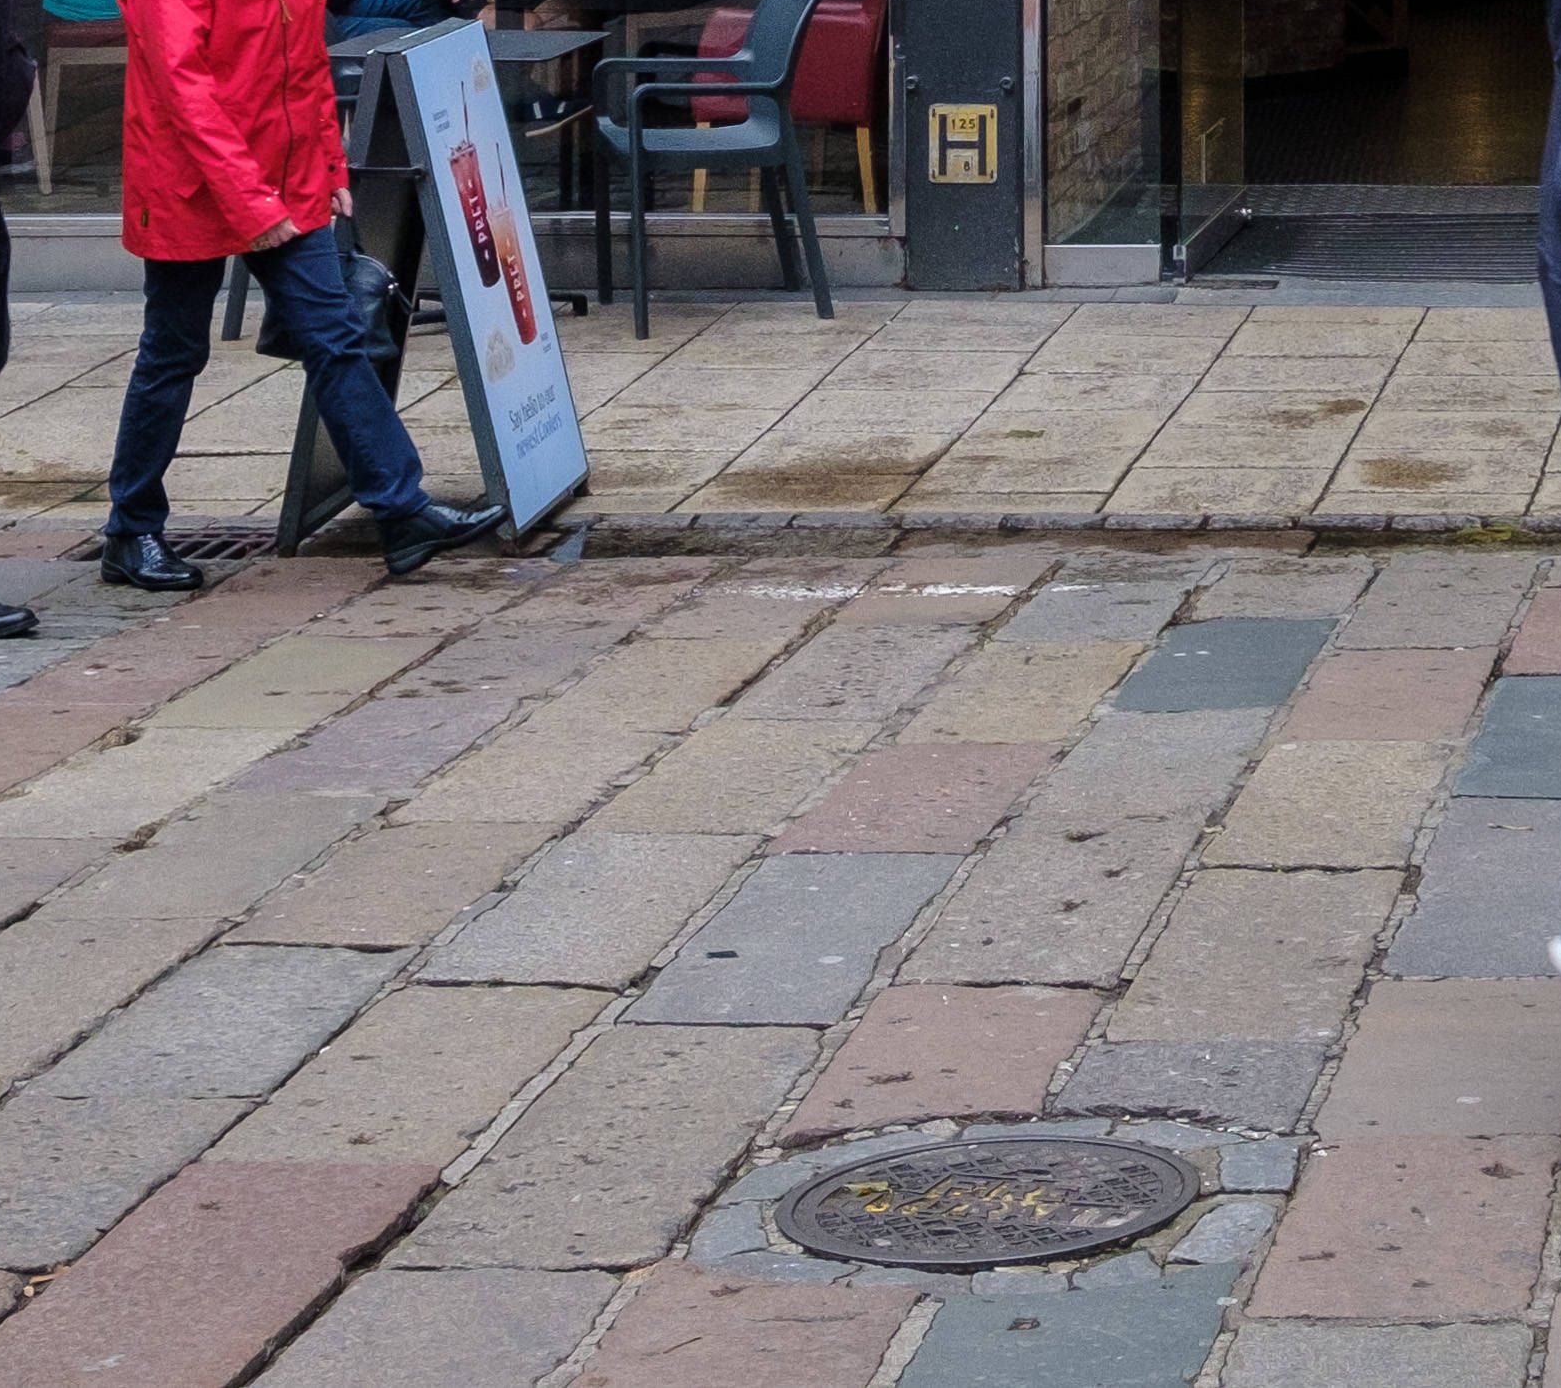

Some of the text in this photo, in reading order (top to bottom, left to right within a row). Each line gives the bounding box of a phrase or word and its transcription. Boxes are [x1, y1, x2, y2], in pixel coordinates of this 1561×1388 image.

[938, 113, 987, 176] H
[951, 118, 976, 130] 125
[471, 192, 494, 247] PRET
[505, 253, 528, 303] PRET
[508, 409, 524, 432] Say
[521, 395, 539, 422] hello
